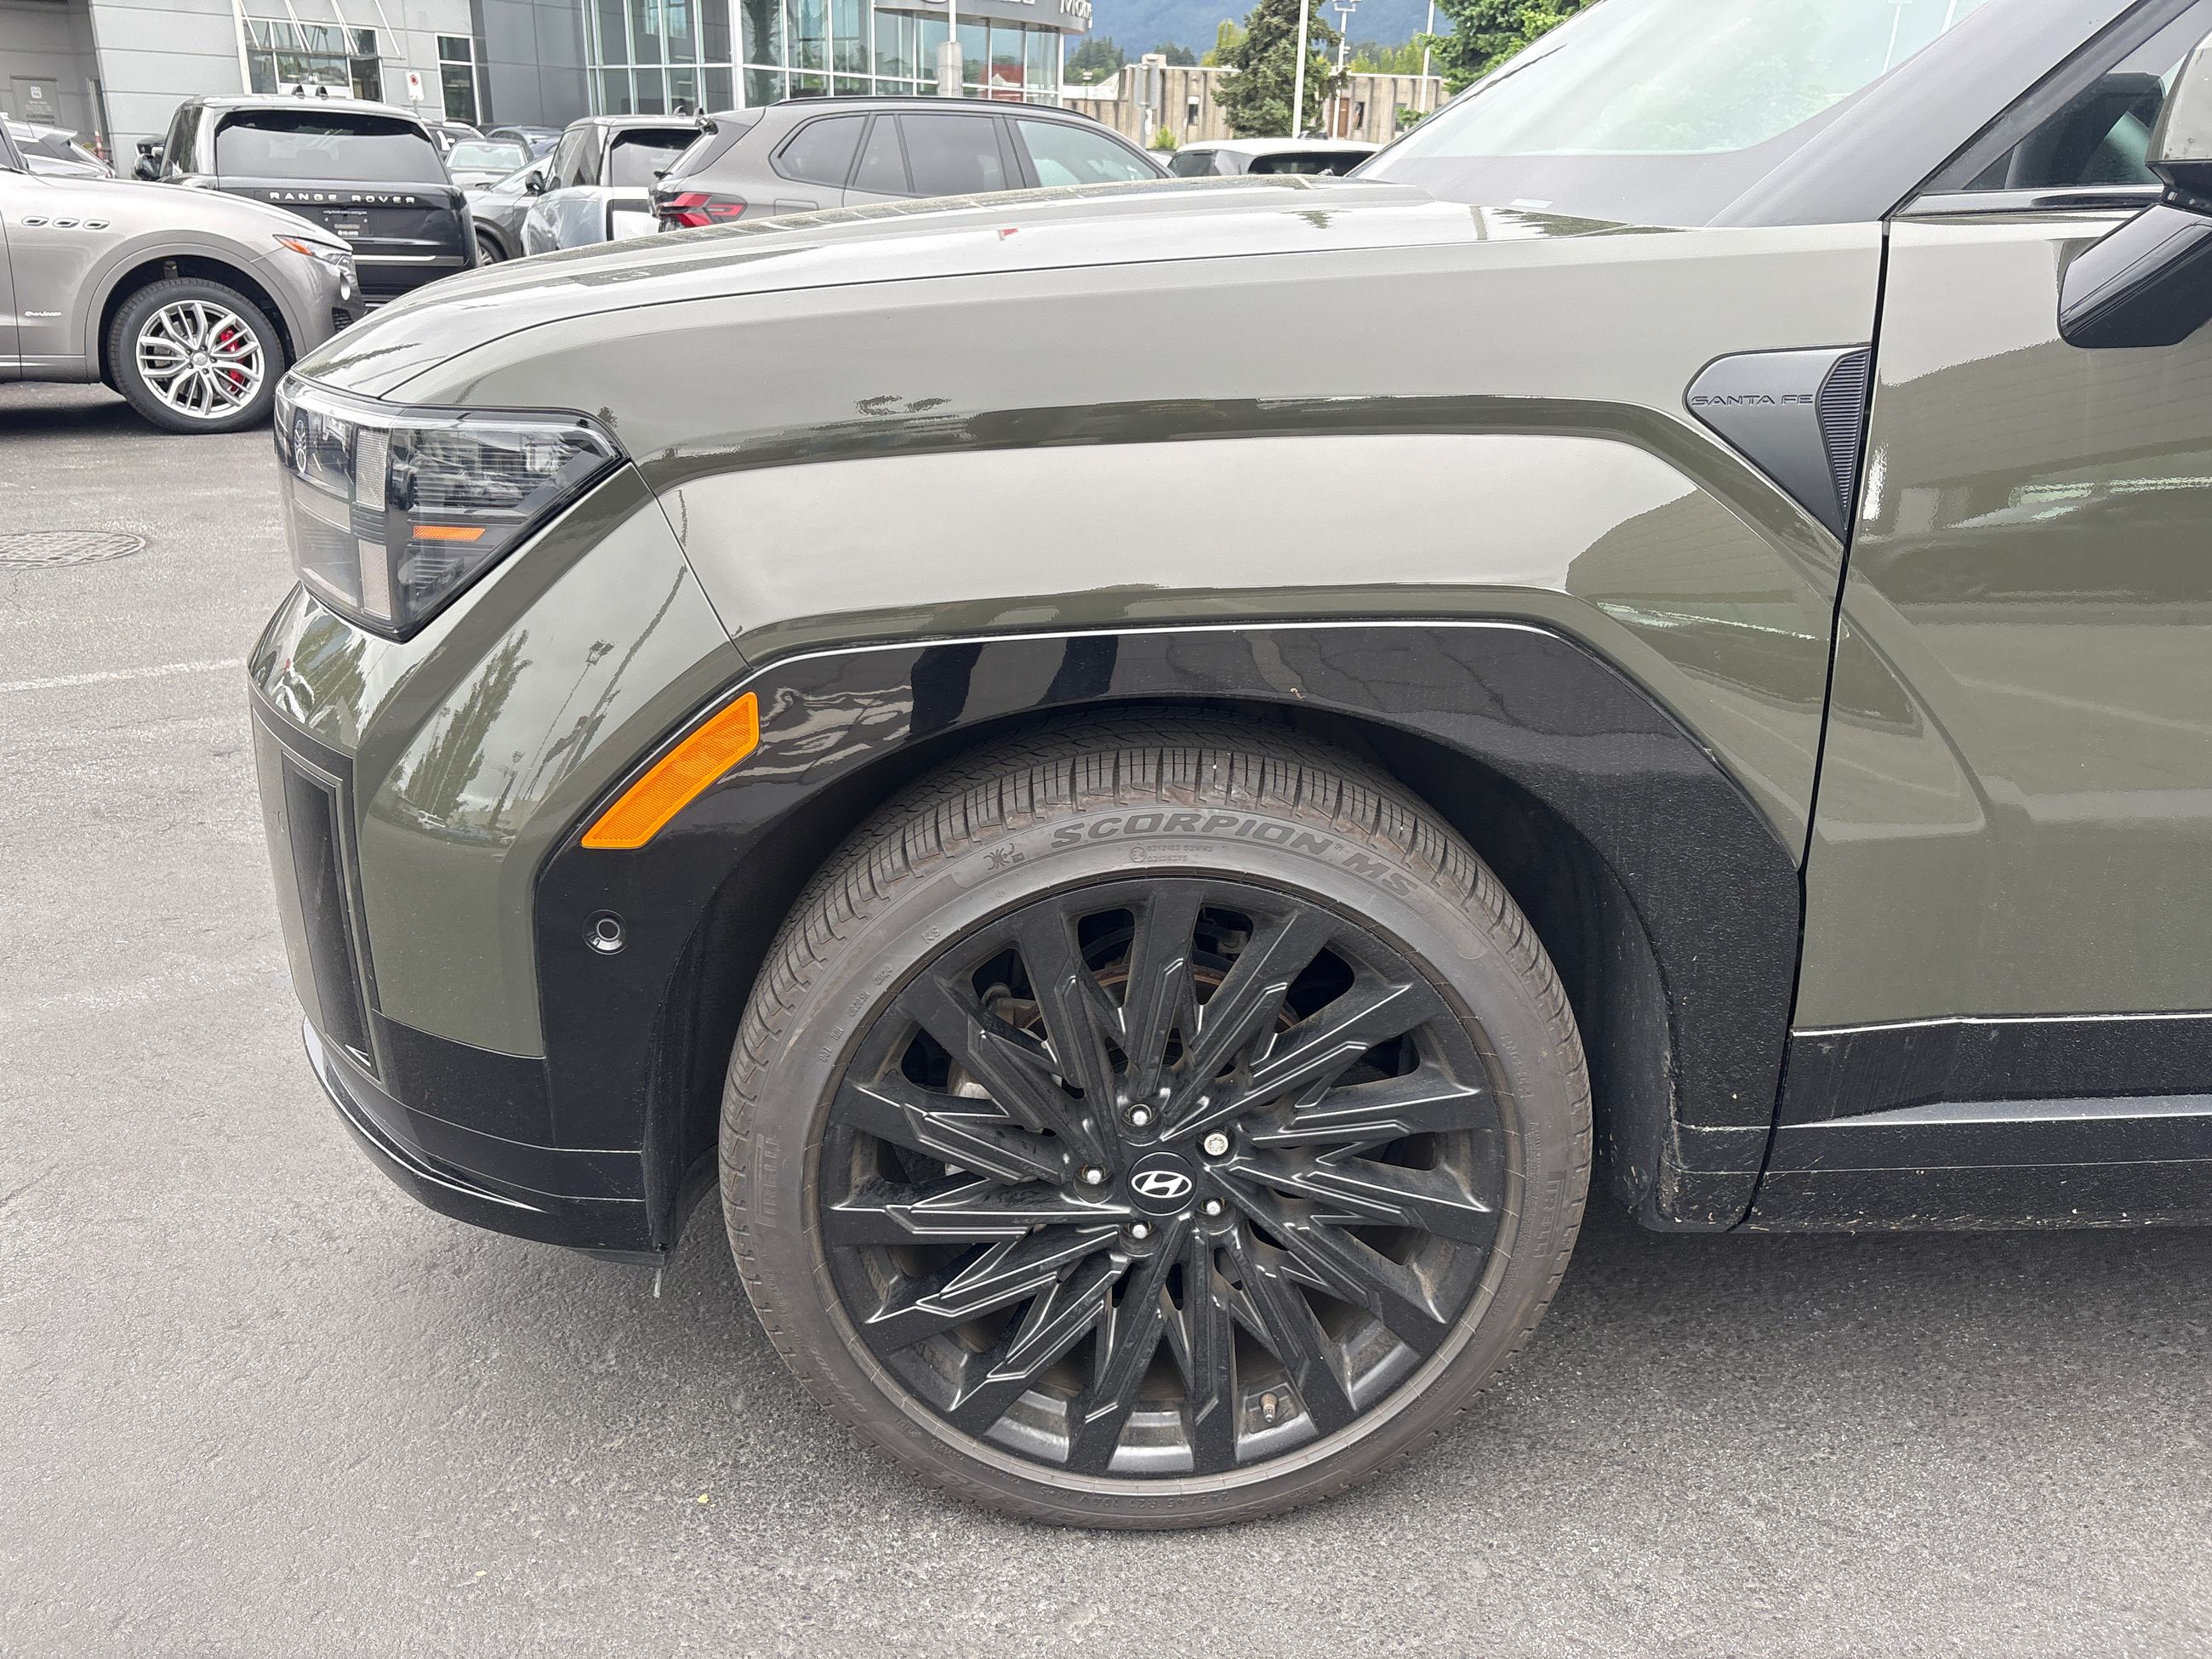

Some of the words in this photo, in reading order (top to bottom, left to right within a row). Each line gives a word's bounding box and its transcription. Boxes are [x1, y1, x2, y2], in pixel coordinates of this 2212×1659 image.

[269, 191, 338, 202] RANGE
[351, 195, 415, 204] ROVER
[1691, 395, 1776, 407] SANTA
[1781, 394, 1814, 406] FE
[1342, 852, 1419, 898] MS
